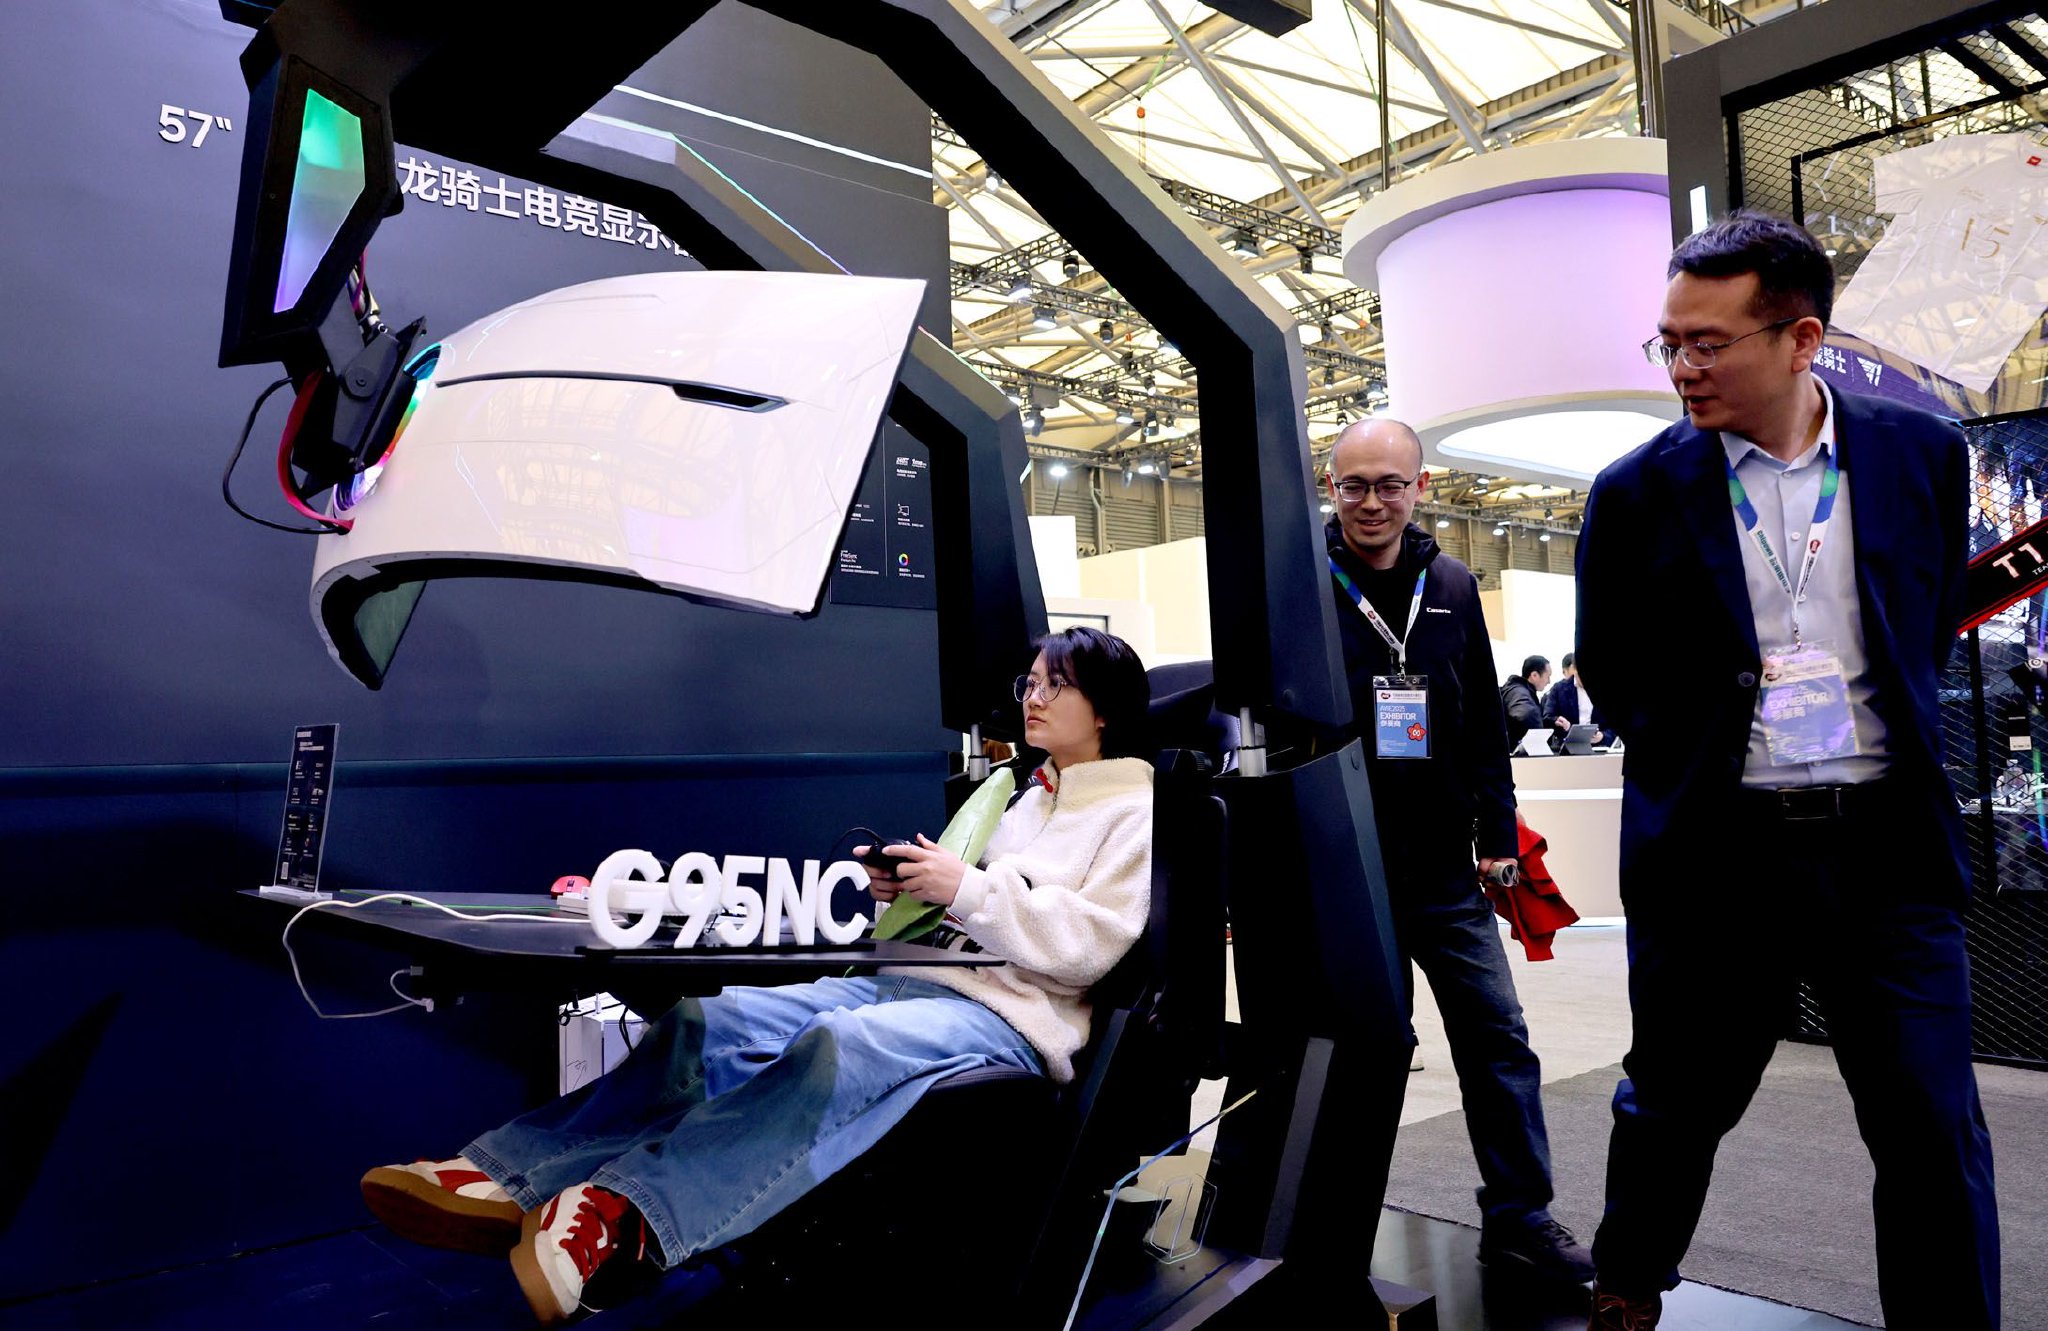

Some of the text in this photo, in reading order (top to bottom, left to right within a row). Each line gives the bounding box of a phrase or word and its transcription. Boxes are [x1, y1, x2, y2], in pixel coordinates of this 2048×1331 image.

[158, 104, 232, 148] 57"
[398, 156, 693, 258] 龙骑士电竞显示
[1380, 712, 1417, 720] EXHIBITOR
[588, 848, 871, 950] G95NC
